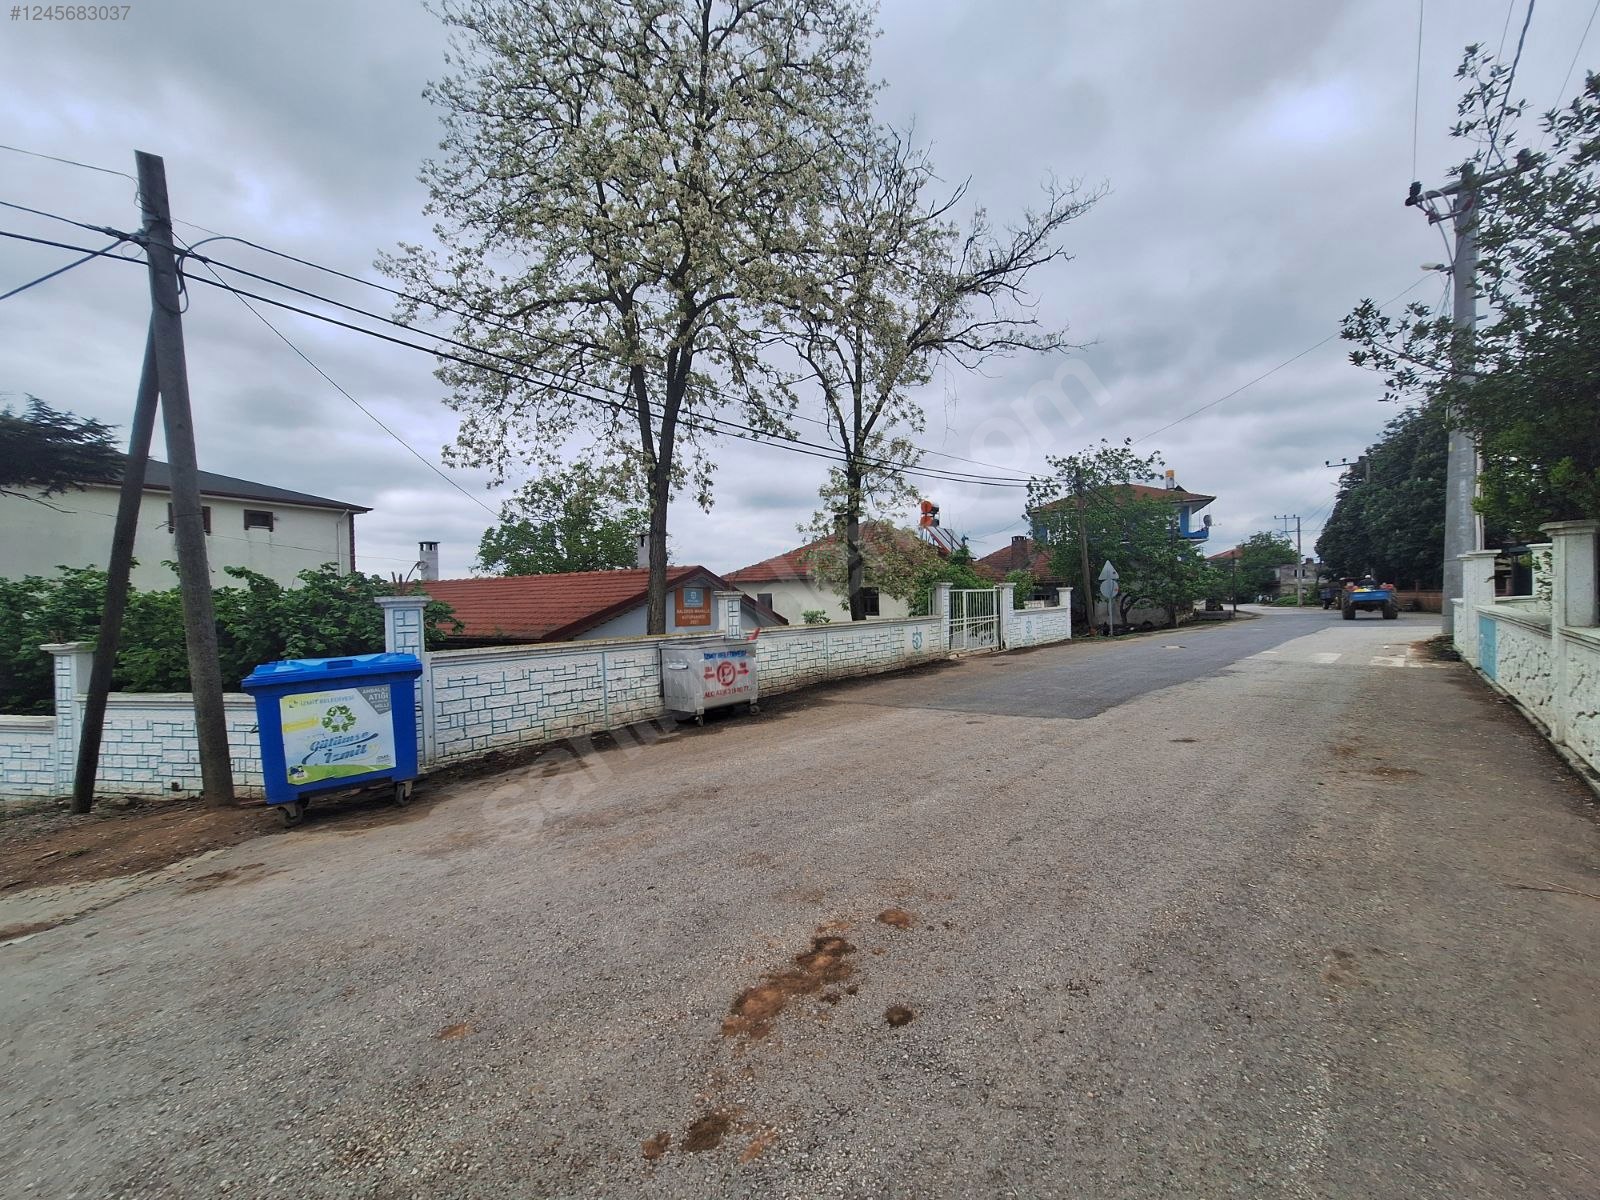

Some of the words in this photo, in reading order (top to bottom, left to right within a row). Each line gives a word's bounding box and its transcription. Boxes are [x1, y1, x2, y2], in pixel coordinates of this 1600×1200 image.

[369, 691, 389, 701] ATIĞI
[309, 732, 369, 754] Gülümse
[324, 744, 368, 763] İzmit
